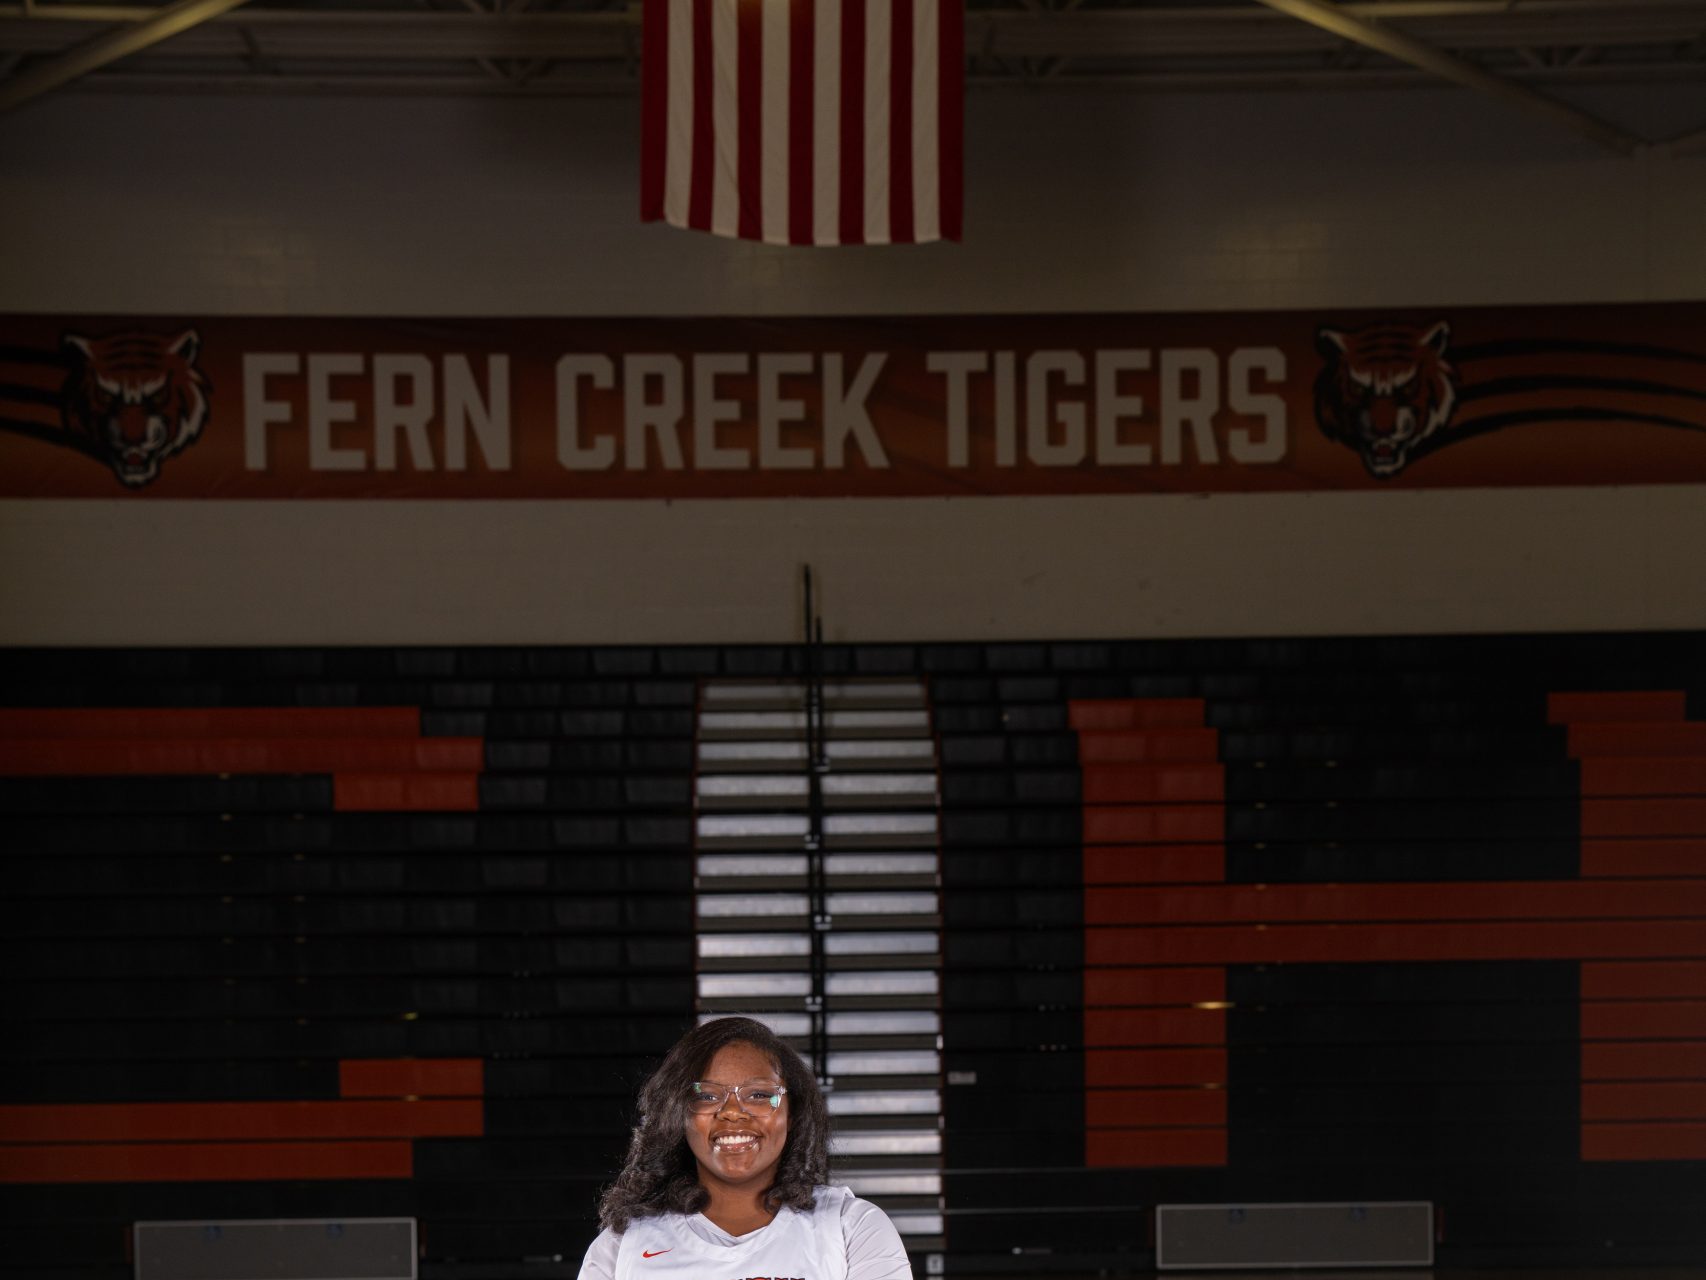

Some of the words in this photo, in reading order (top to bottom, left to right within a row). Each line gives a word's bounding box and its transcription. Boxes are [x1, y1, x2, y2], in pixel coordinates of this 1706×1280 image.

[241, 351, 511, 473] FERN
[555, 350, 891, 472] CREEK
[925, 345, 1288, 469] TIGERS
